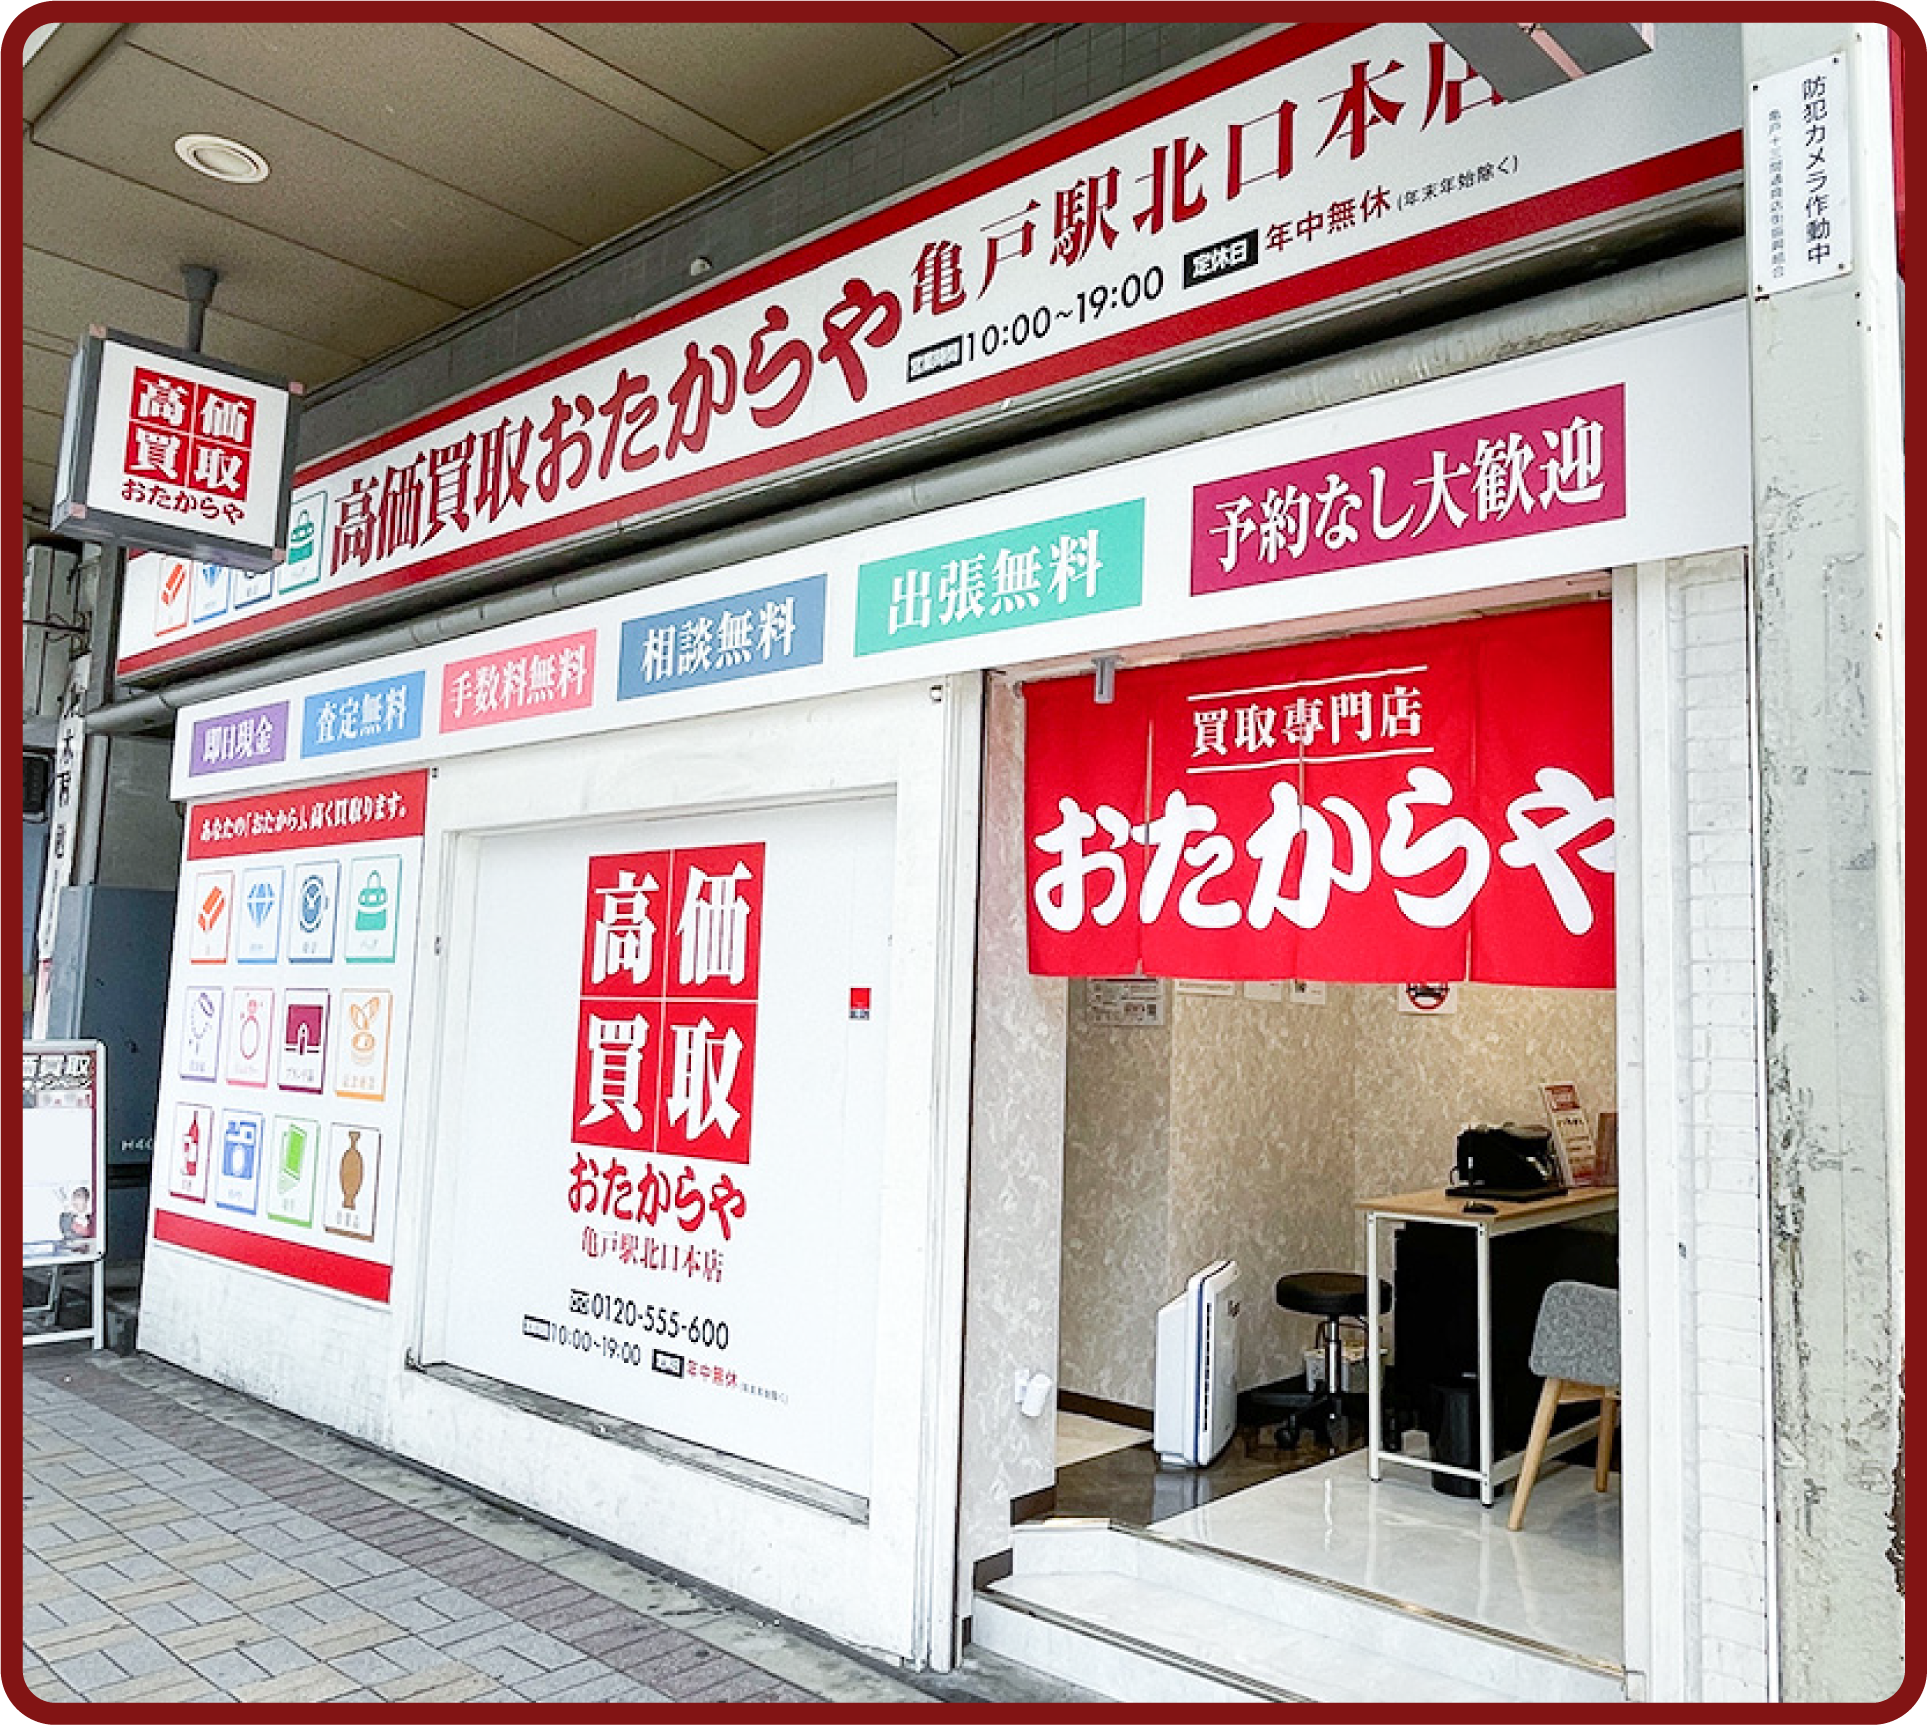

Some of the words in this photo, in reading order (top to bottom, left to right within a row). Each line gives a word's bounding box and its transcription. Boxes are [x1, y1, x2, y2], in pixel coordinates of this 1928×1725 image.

[1802, 76, 1830, 265] 防犯カメラ作動中
[1265, 186, 1391, 253] 年中無休
[137, 377, 250, 443] 高価
[121, 478, 245, 526] おたからや
[129, 430, 244, 493] 買取
[1209, 416, 1606, 573] 予約なし大歓迎
[887, 530, 1105, 635] 出張無料
[639, 596, 796, 684] 相談無料
[315, 684, 408, 744] 査定無料
[452, 645, 588, 719] 手数料無料
[202, 714, 273, 765] 即日現金
[1034, 766, 1616, 936] おたからや
[591, 860, 752, 985] 高価
[579, 1013, 743, 1141] 買取
[568, 1152, 747, 1241] おたからや
[592, 1292, 729, 1350] 0120-555-600
